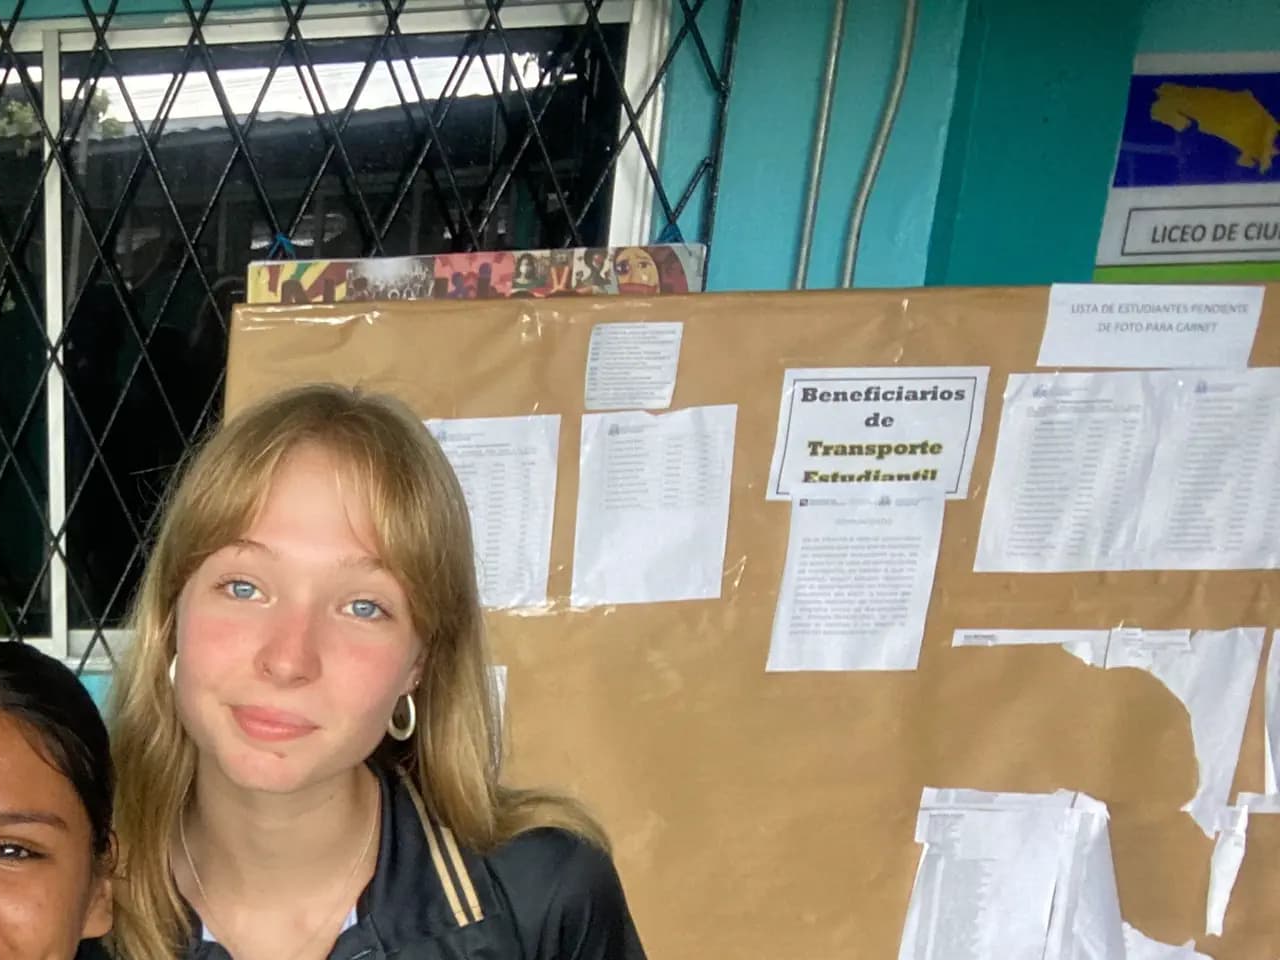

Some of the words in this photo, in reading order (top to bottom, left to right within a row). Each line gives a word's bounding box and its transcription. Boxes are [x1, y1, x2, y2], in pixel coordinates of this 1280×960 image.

[1151, 224, 1207, 244] LICEO
[1212, 223, 1239, 242] DE
[1244, 221, 1280, 242] CIU
[1071, 303, 1098, 314] LISTA
[1101, 303, 1115, 314] DE
[1117, 303, 1188, 314] ESTUDIANTES
[1097, 322, 1112, 333] DE
[1114, 322, 1144, 333] FOTO
[1145, 322, 1173, 333] PARA
[1175, 322, 1218, 333] CARNET
[801, 386, 966, 403] Beneficiarios
[864, 412, 895, 428] de
[807, 440, 943, 460] Transporte
[802, 469, 937, 484] Estudiantil
